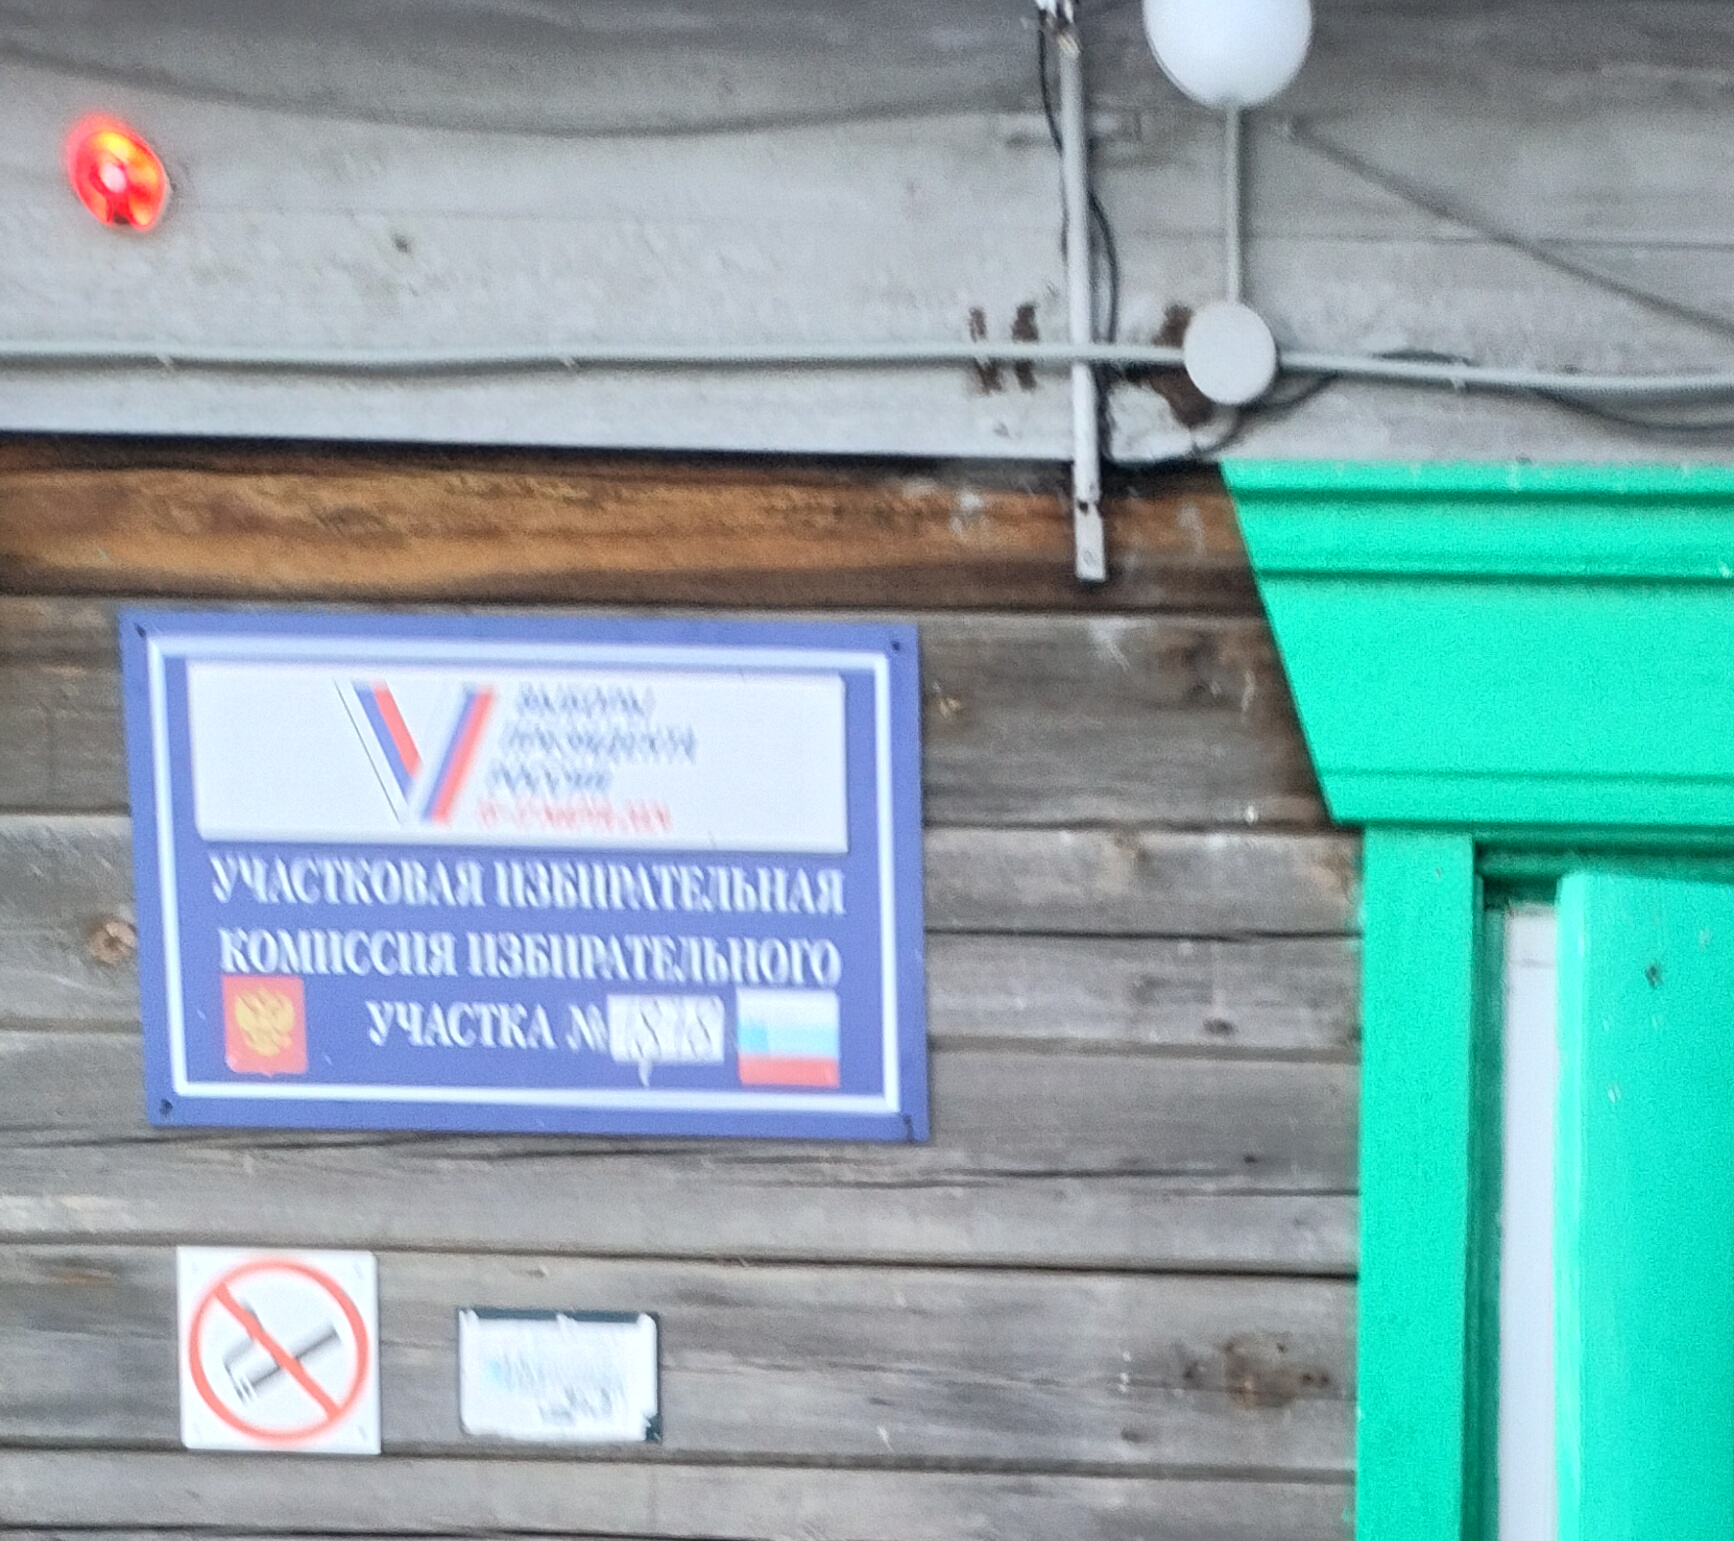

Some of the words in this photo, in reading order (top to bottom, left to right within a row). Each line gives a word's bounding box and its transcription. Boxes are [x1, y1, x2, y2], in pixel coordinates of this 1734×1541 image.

[210, 855, 484, 907] УЧАСТКОВАЯ
[495, 860, 845, 915] ИЗБИРАТЕЛЬНАЯ
[218, 927, 459, 977] КОМИССИЯ
[466, 930, 842, 986] ИЗБИРАТЕЛЬНОГО
[368, 1001, 557, 1050] УЧАСТКА
